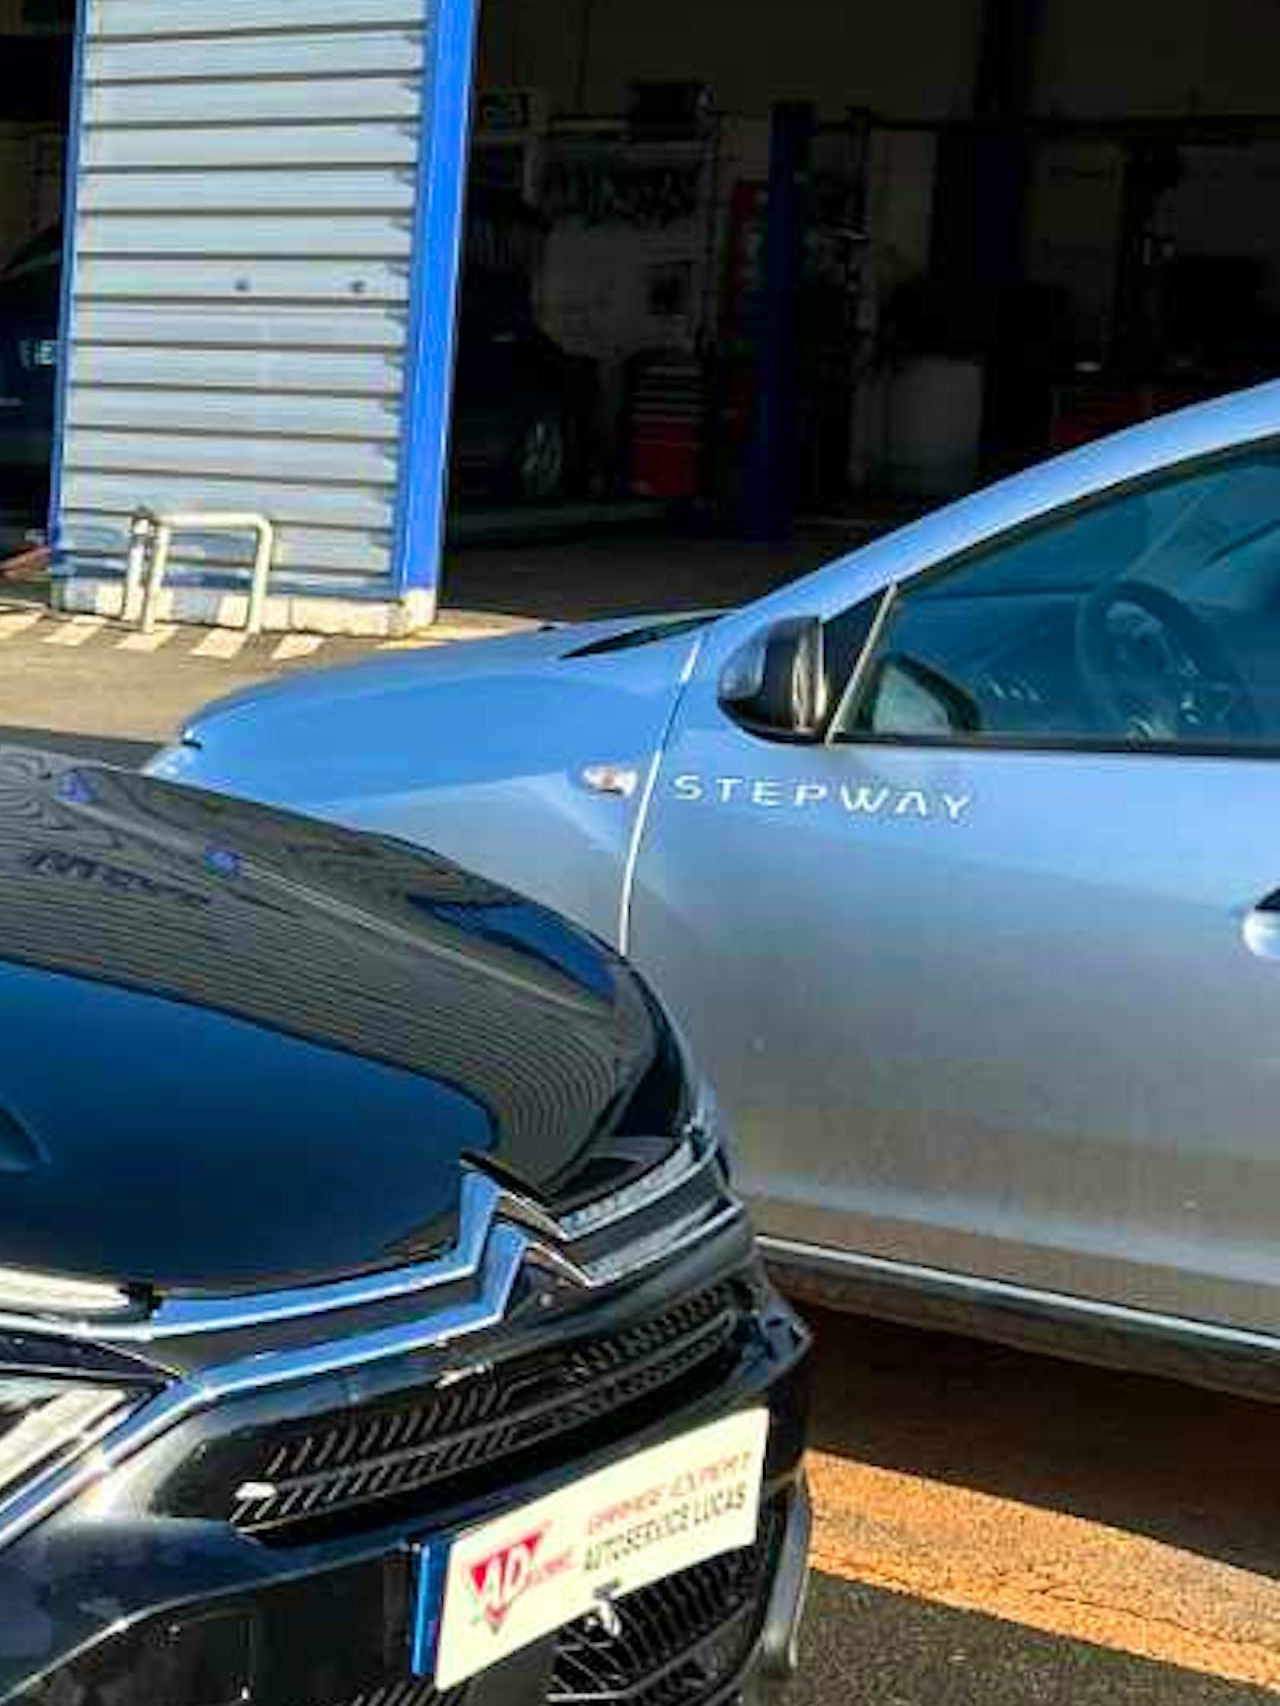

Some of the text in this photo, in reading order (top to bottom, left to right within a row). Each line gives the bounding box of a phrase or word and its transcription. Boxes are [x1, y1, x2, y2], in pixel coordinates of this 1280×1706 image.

[673, 774, 972, 819] STEPWAY
[693, 1484, 748, 1530] LUCAS
[472, 1541, 530, 1624] AD
